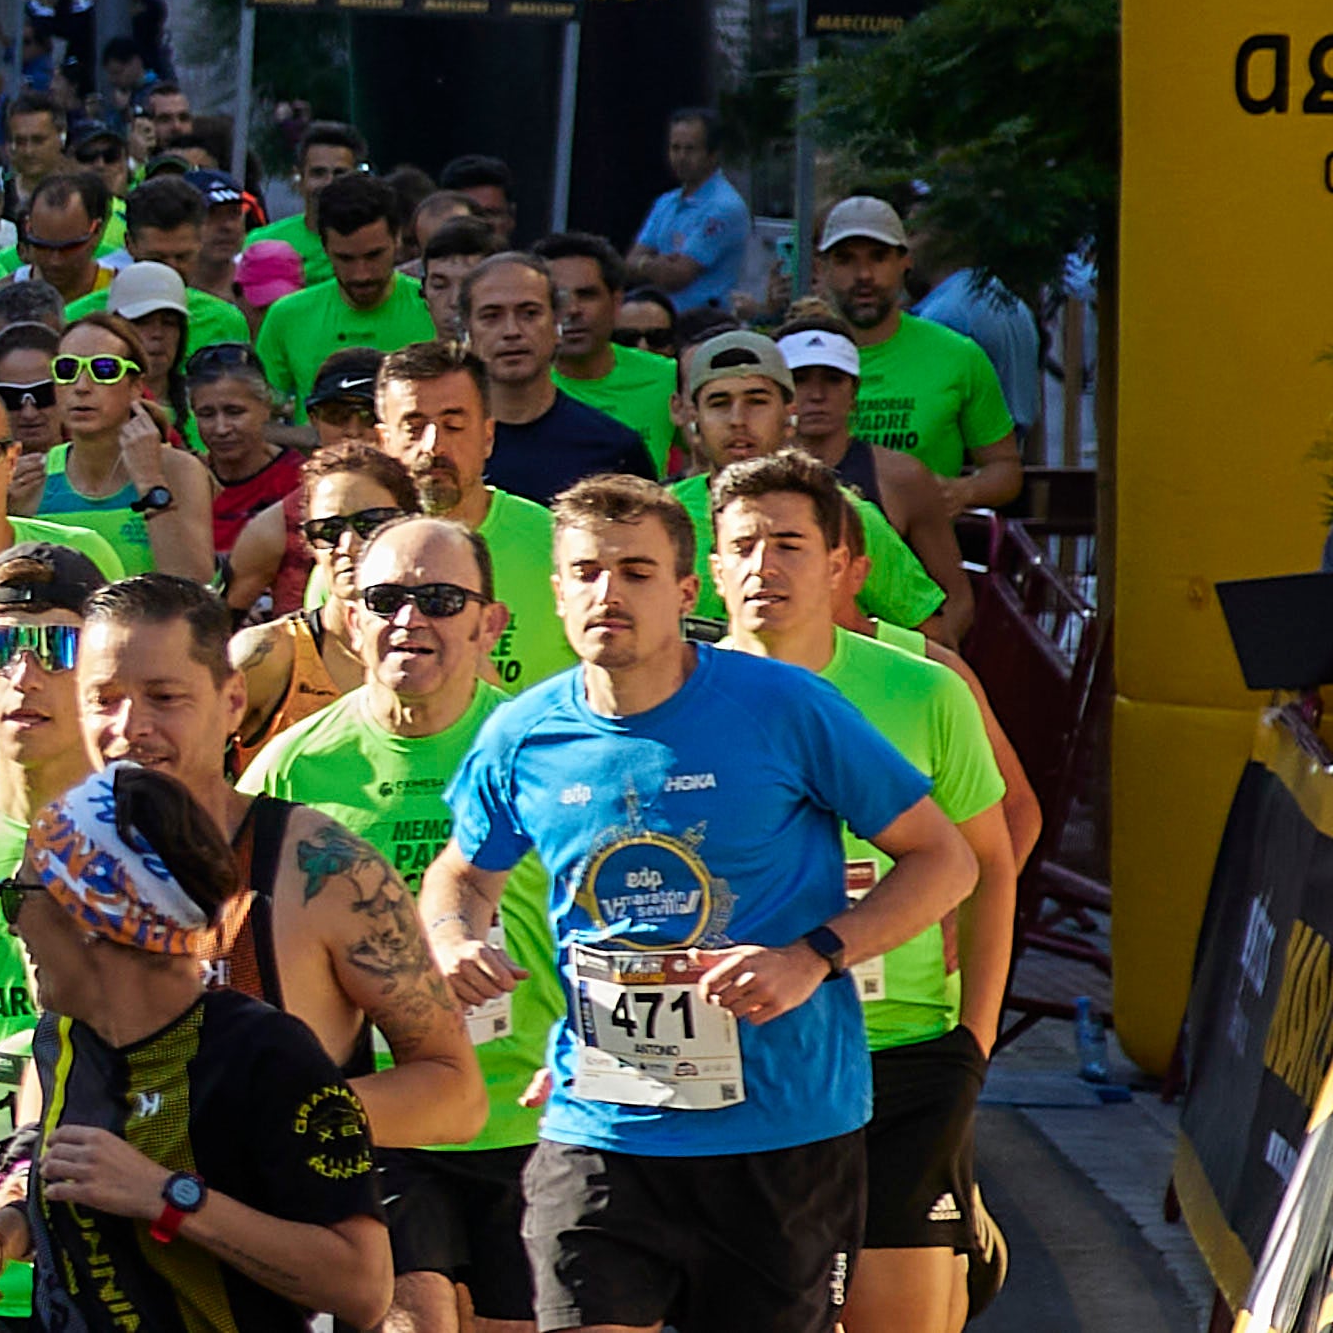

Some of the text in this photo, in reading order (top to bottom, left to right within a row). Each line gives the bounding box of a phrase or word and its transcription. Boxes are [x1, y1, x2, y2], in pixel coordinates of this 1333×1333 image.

[560, 782, 592, 806] edp
[664, 773, 717, 792] HOKA
[625, 866, 663, 892] edp
[611, 990, 696, 1040] 471
